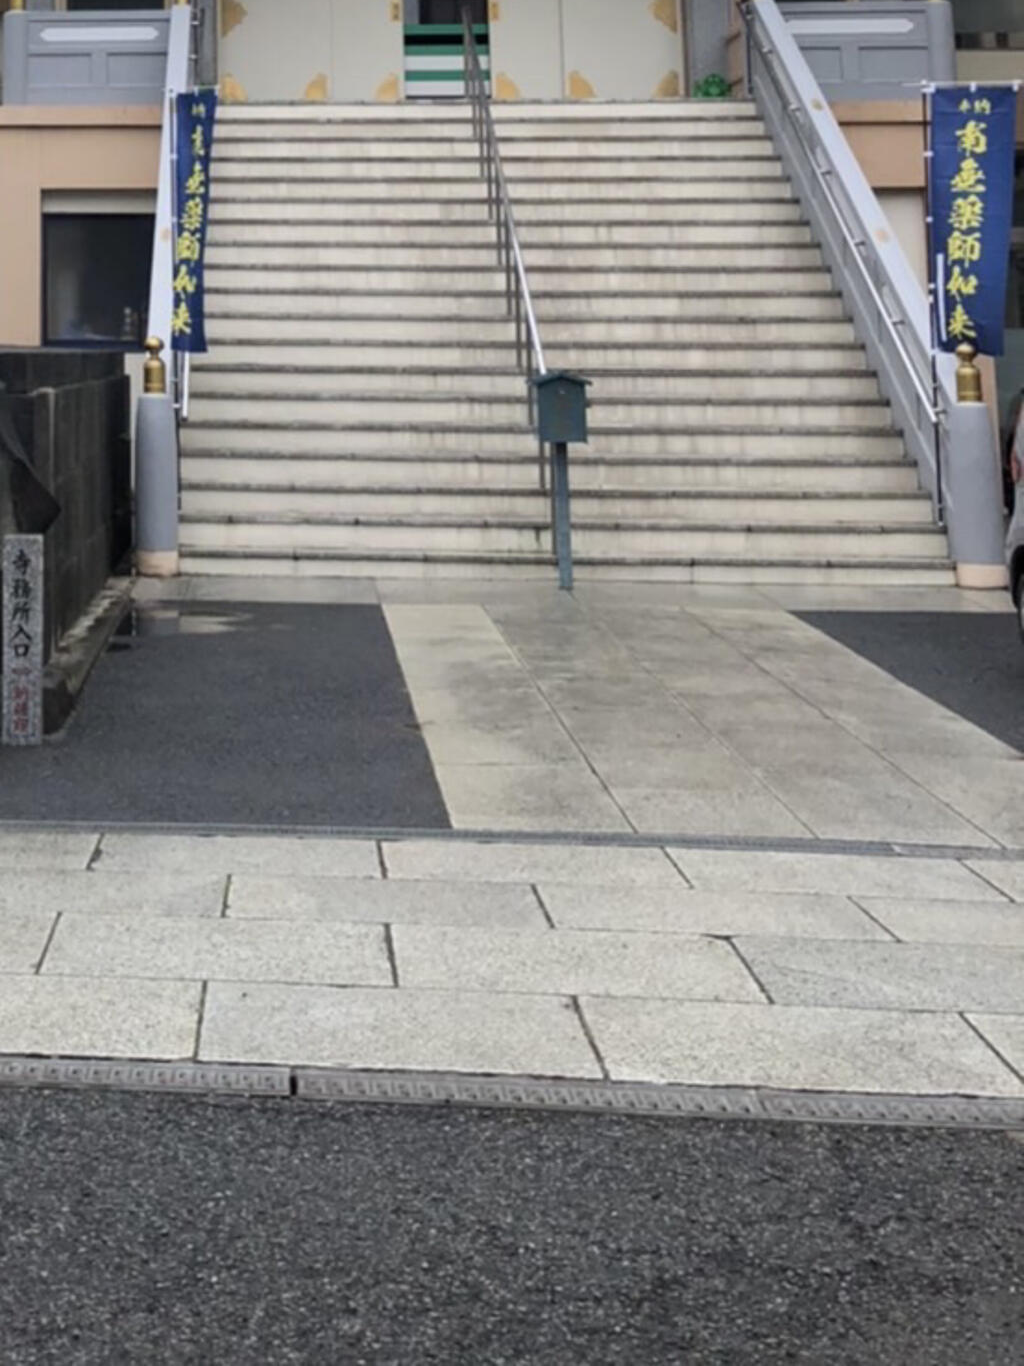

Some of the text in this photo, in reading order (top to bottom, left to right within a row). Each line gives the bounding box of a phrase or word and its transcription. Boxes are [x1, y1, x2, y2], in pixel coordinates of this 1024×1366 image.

[947, 119, 988, 340] 南無薬師如来
[12, 548, 33, 658] 寺務所入口
